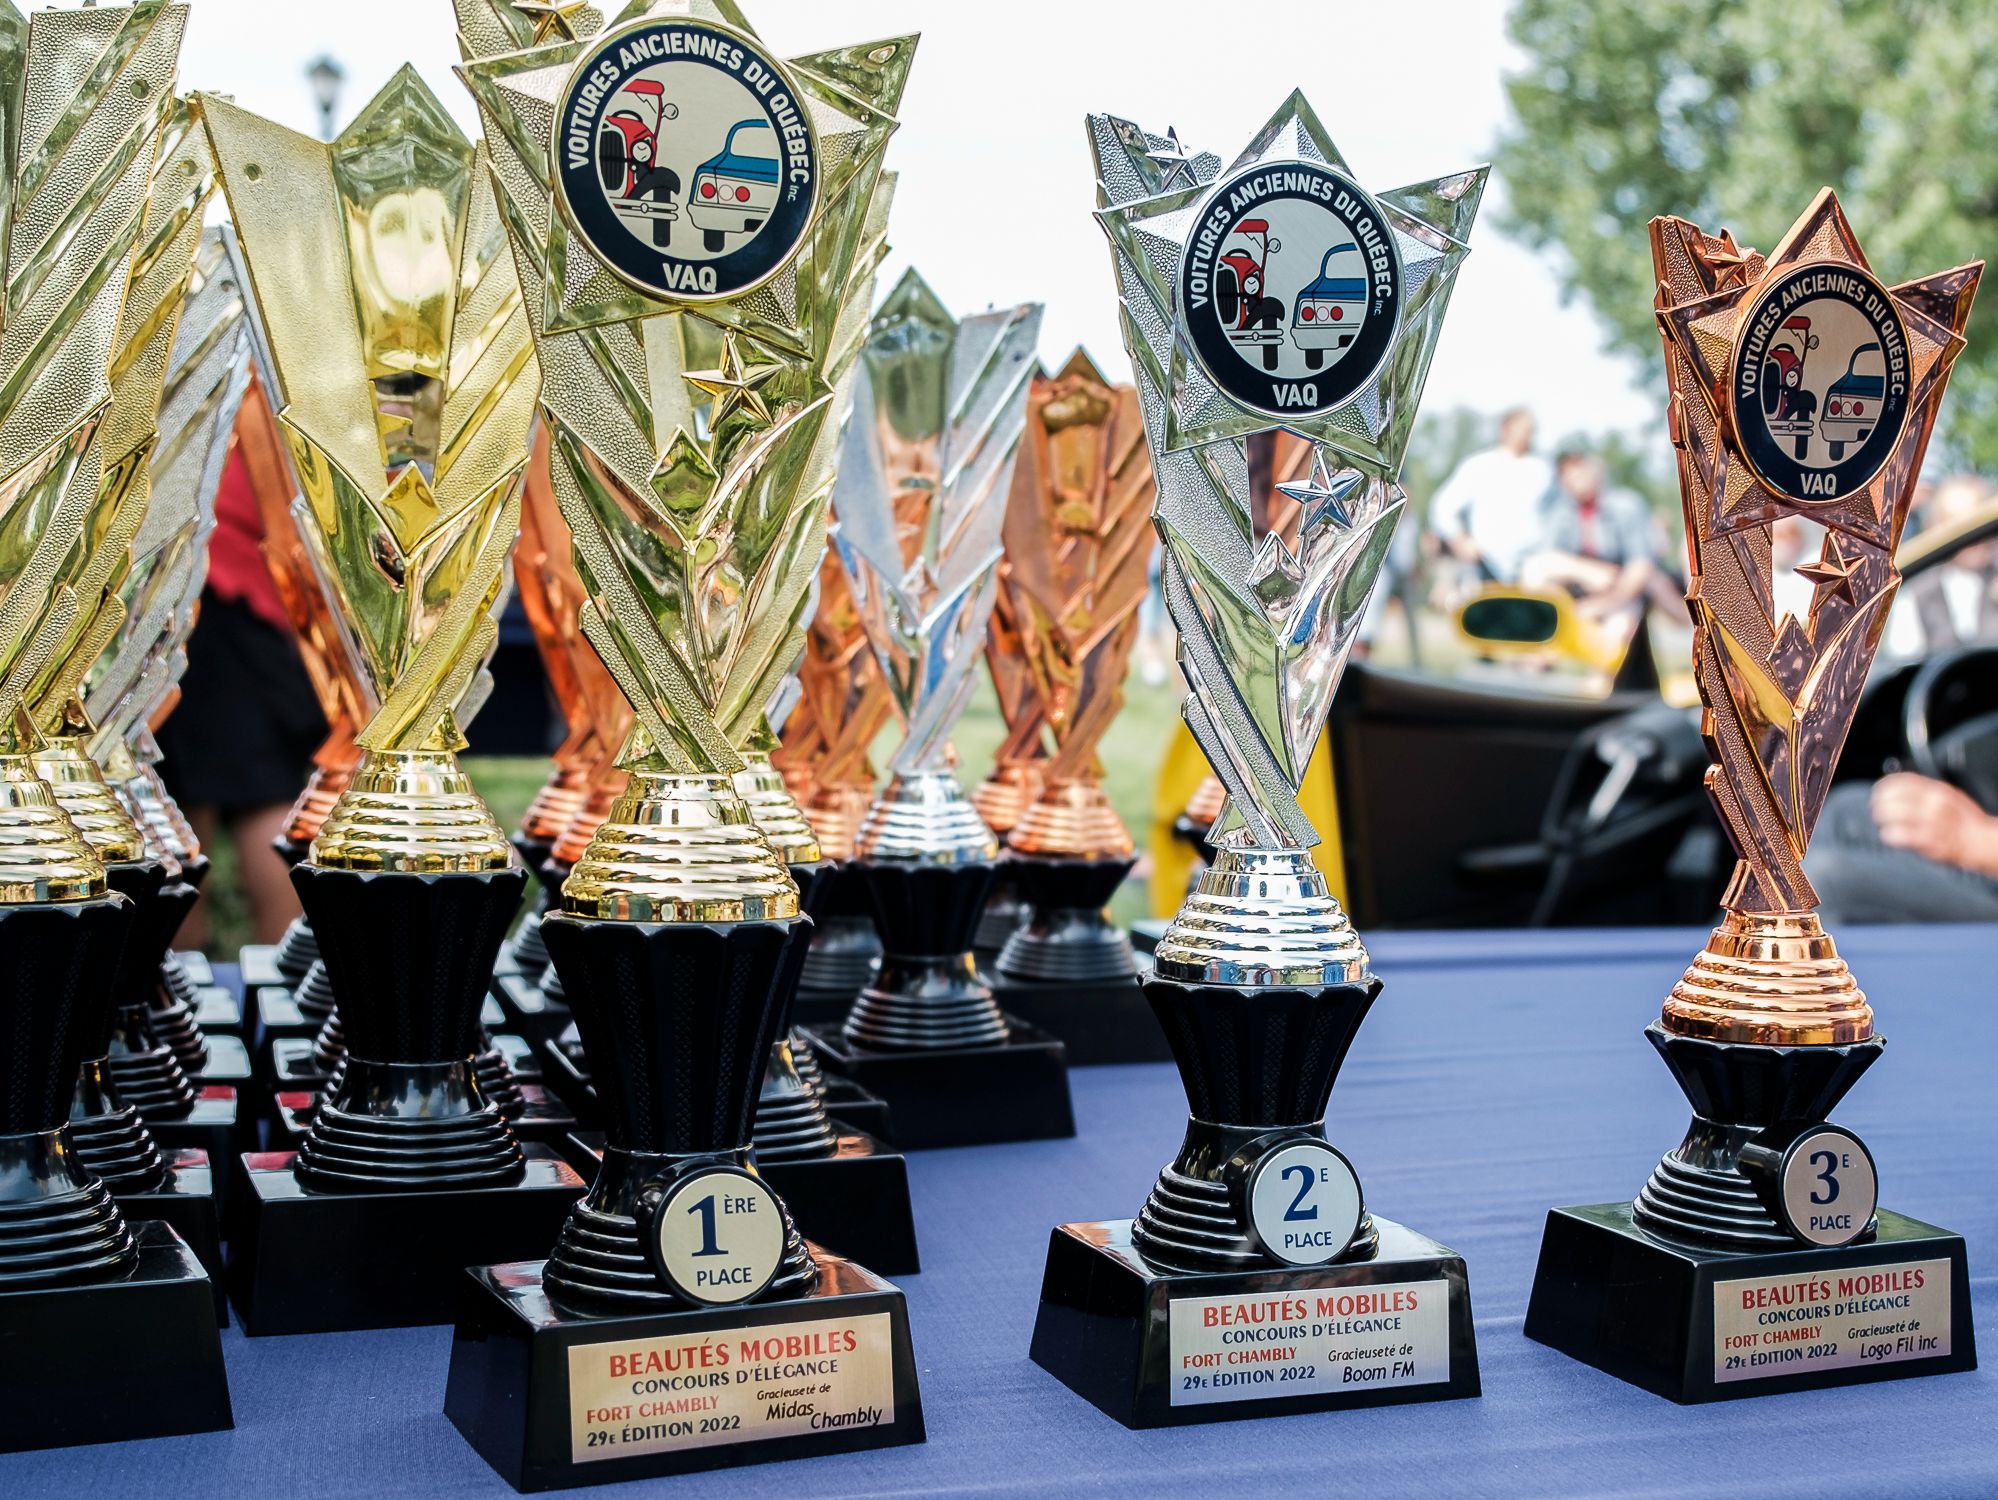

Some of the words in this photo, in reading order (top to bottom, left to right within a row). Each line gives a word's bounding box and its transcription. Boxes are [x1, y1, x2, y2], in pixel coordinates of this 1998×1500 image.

[569, 61, 620, 169] VOITURES
[619, 33, 742, 70] ANCIENNES
[743, 62, 776, 96] DU
[770, 94, 809, 185] QUÉBEC
[1190, 209, 1231, 309] VOITURES
[1230, 173, 1334, 212] ANCIENNES
[1334, 191, 1361, 221] DU
[1357, 218, 1392, 298] QUÉBEC
[663, 263, 717, 293] VAQ
[1742, 306, 1781, 398] VOITURES
[1782, 274, 1866, 309] ANCIENNES
[1865, 294, 1886, 319] DU
[1882, 319, 1904, 396] QUÉBEC
[1273, 384, 1317, 406] VAQ
[1801, 473, 1836, 495] VAQ
[1810, 1215, 1850, 1230] PLACE
[1285, 1231, 1332, 1248] PLACE
[697, 1267, 752, 1286] PLACE
[1742, 1275, 1830, 1309] BEAUTÉS
[1838, 1269, 1924, 1297] MOBILES
[1203, 1294, 1307, 1327] BEAUTÉS
[1317, 1291, 1417, 1317] MOBILES
[1759, 1304, 1830, 1325] CONCOURS
[1835, 1295, 1910, 1316] D'ÉLÉGANCE
[1222, 1324, 1306, 1344] CONCOURS
[1312, 1317, 1401, 1337] D'ÉLÉGANCE
[1725, 1334, 1759, 1349] FORT
[1763, 1325, 1822, 1344] CHAMBLY
[1848, 1322, 1905, 1339] Gracieuseté
[1908, 1320, 1920, 1331] de
[610, 1337, 729, 1377] BEAUTÉS
[741, 1329, 857, 1362] MOBILES
[1184, 1353, 1222, 1368] FORT
[1228, 1347, 1297, 1364] CHAMBLY
[1328, 1346, 1395, 1362] Gracieuseté
[1399, 1345, 1413, 1355] de
[1750, 1347, 1802, 1366] ÉDITION
[1807, 1343, 1837, 1358] 2022
[1860, 1341, 1892, 1360] Logo
[1896, 1337, 1913, 1353] Fil
[1919, 1336, 1937, 1351] inc
[632, 1371, 729, 1395] CONCOURS
[736, 1359, 838, 1384] D'ÉLÉGANCE
[1213, 1367, 1274, 1387] ÉDITION
[1280, 1365, 1315, 1380] 2022
[1343, 1365, 1386, 1383] Boom
[1392, 1362, 1415, 1378] FM
[757, 1384, 815, 1400] Gracieuseté
[819, 1383, 831, 1393] de
[587, 1404, 635, 1423] FORT
[639, 1395, 719, 1416] CHAMBLY
[766, 1401, 814, 1421] Midas
[810, 1407, 882, 1429] Chambly
[622, 1417, 693, 1442] ÉDITION
[700, 1415, 741, 1433] 2022
